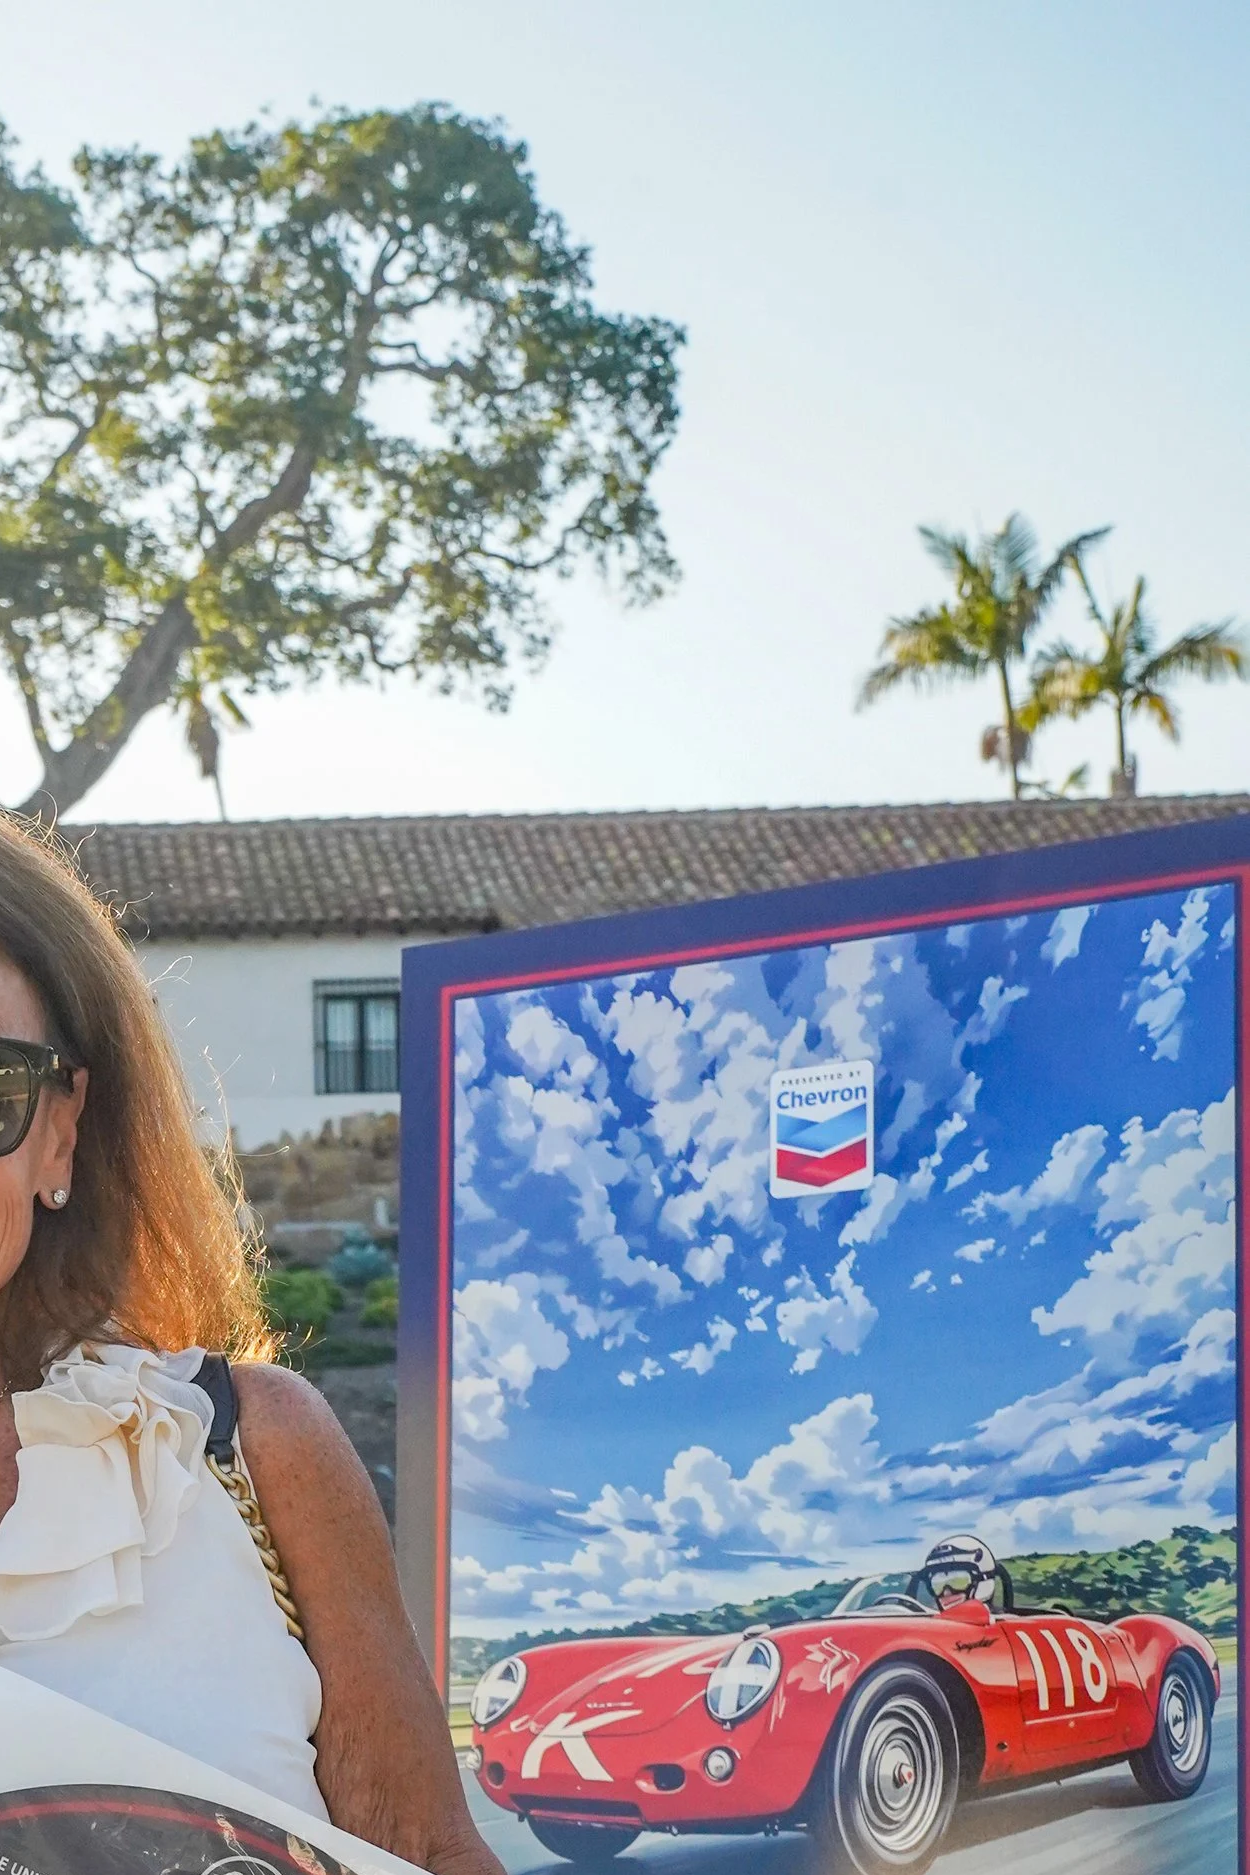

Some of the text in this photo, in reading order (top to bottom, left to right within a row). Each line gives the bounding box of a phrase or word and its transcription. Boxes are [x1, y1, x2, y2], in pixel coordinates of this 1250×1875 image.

[777, 1085, 867, 1109] Chevron
[781, 1072, 843, 1086] PRESENTED
[1015, 1628, 1108, 1711] 118
[521, 1709, 643, 1782] K
